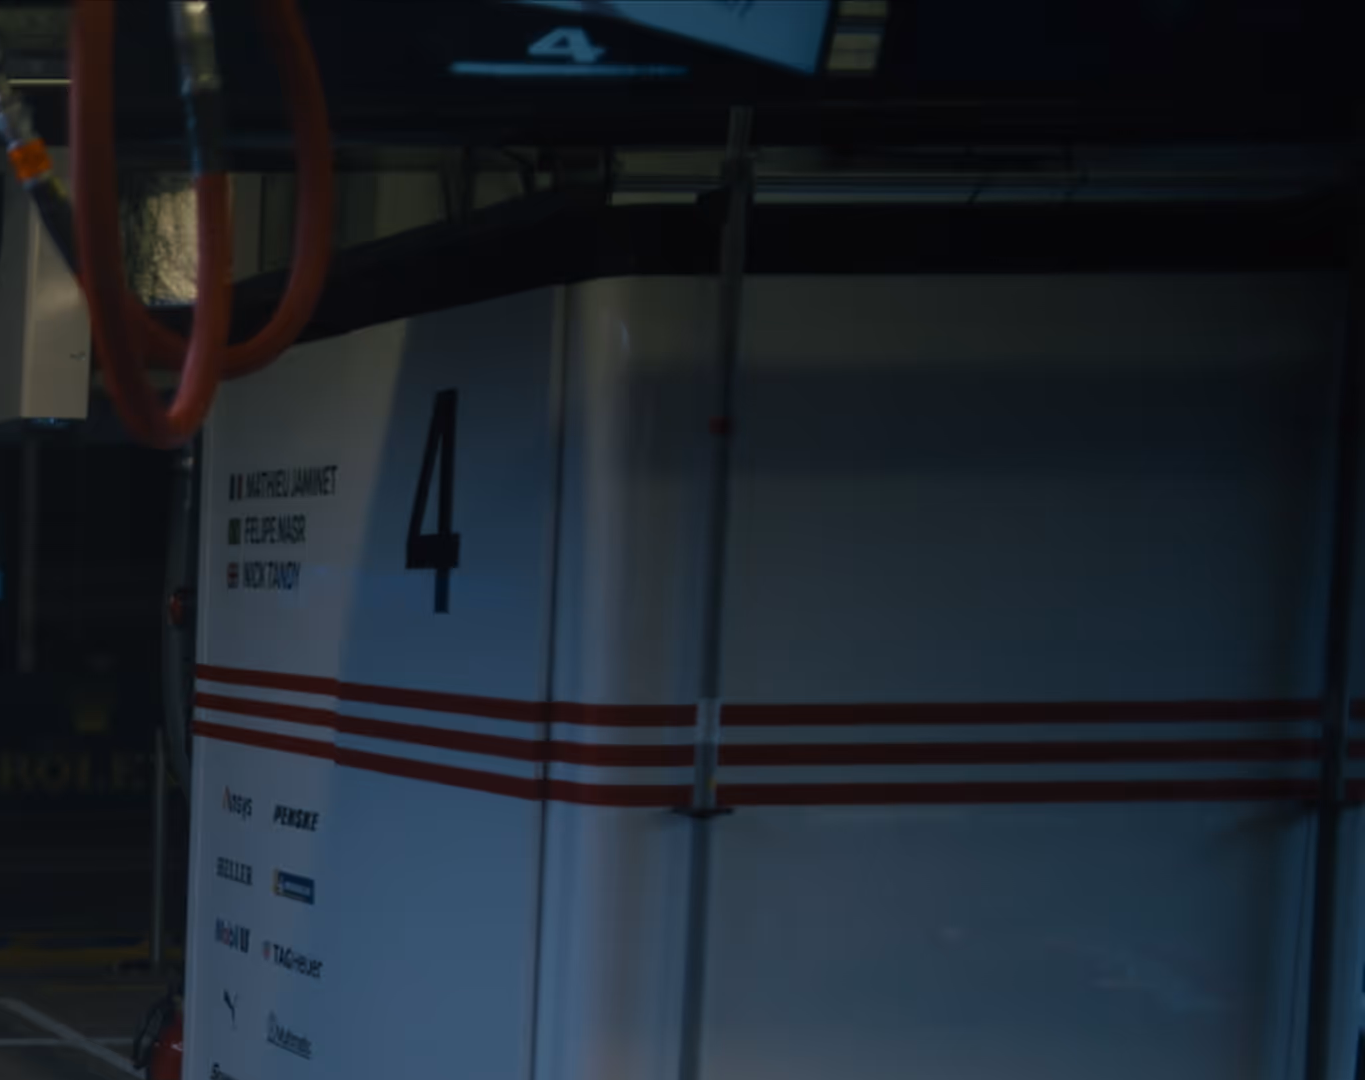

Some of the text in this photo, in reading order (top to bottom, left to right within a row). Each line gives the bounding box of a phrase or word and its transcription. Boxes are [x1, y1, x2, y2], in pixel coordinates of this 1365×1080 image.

[528, 26, 607, 63] 4
[245, 465, 337, 498] MATHIEU JAMINET
[405, 390, 460, 613] 4
[245, 514, 306, 543] FELIPE NASR
[243, 561, 301, 590] NICK TANDY
[274, 804, 319, 832] PENSKE
[215, 856, 253, 886] HELLER
